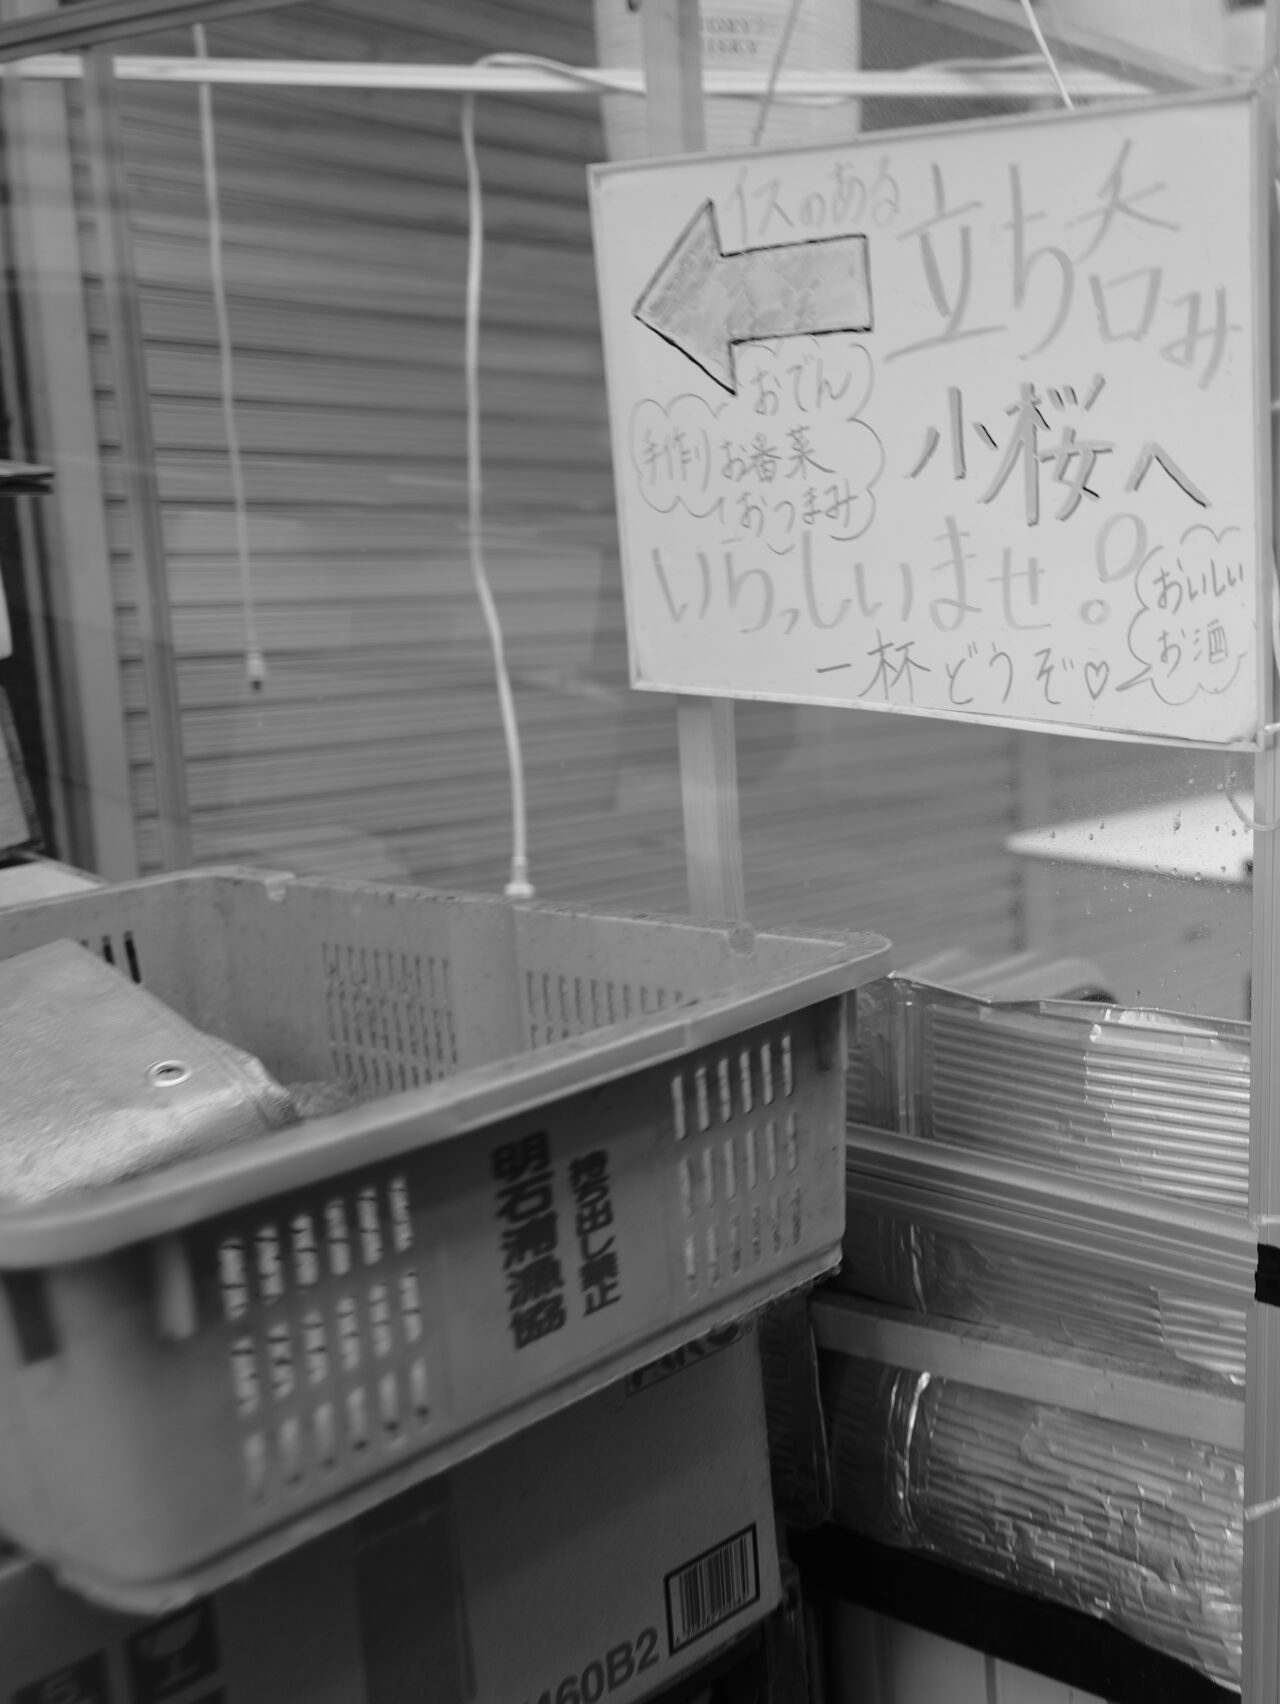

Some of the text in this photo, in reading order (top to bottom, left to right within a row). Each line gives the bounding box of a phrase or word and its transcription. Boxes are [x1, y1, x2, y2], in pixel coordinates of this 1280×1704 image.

[751, 353, 853, 416] おでん
[904, 373, 1212, 528] 小桜へ
[737, 478, 859, 538] おつまみ
[1152, 557, 1244, 615] おいしい
[1157, 618, 1229, 678] お酒
